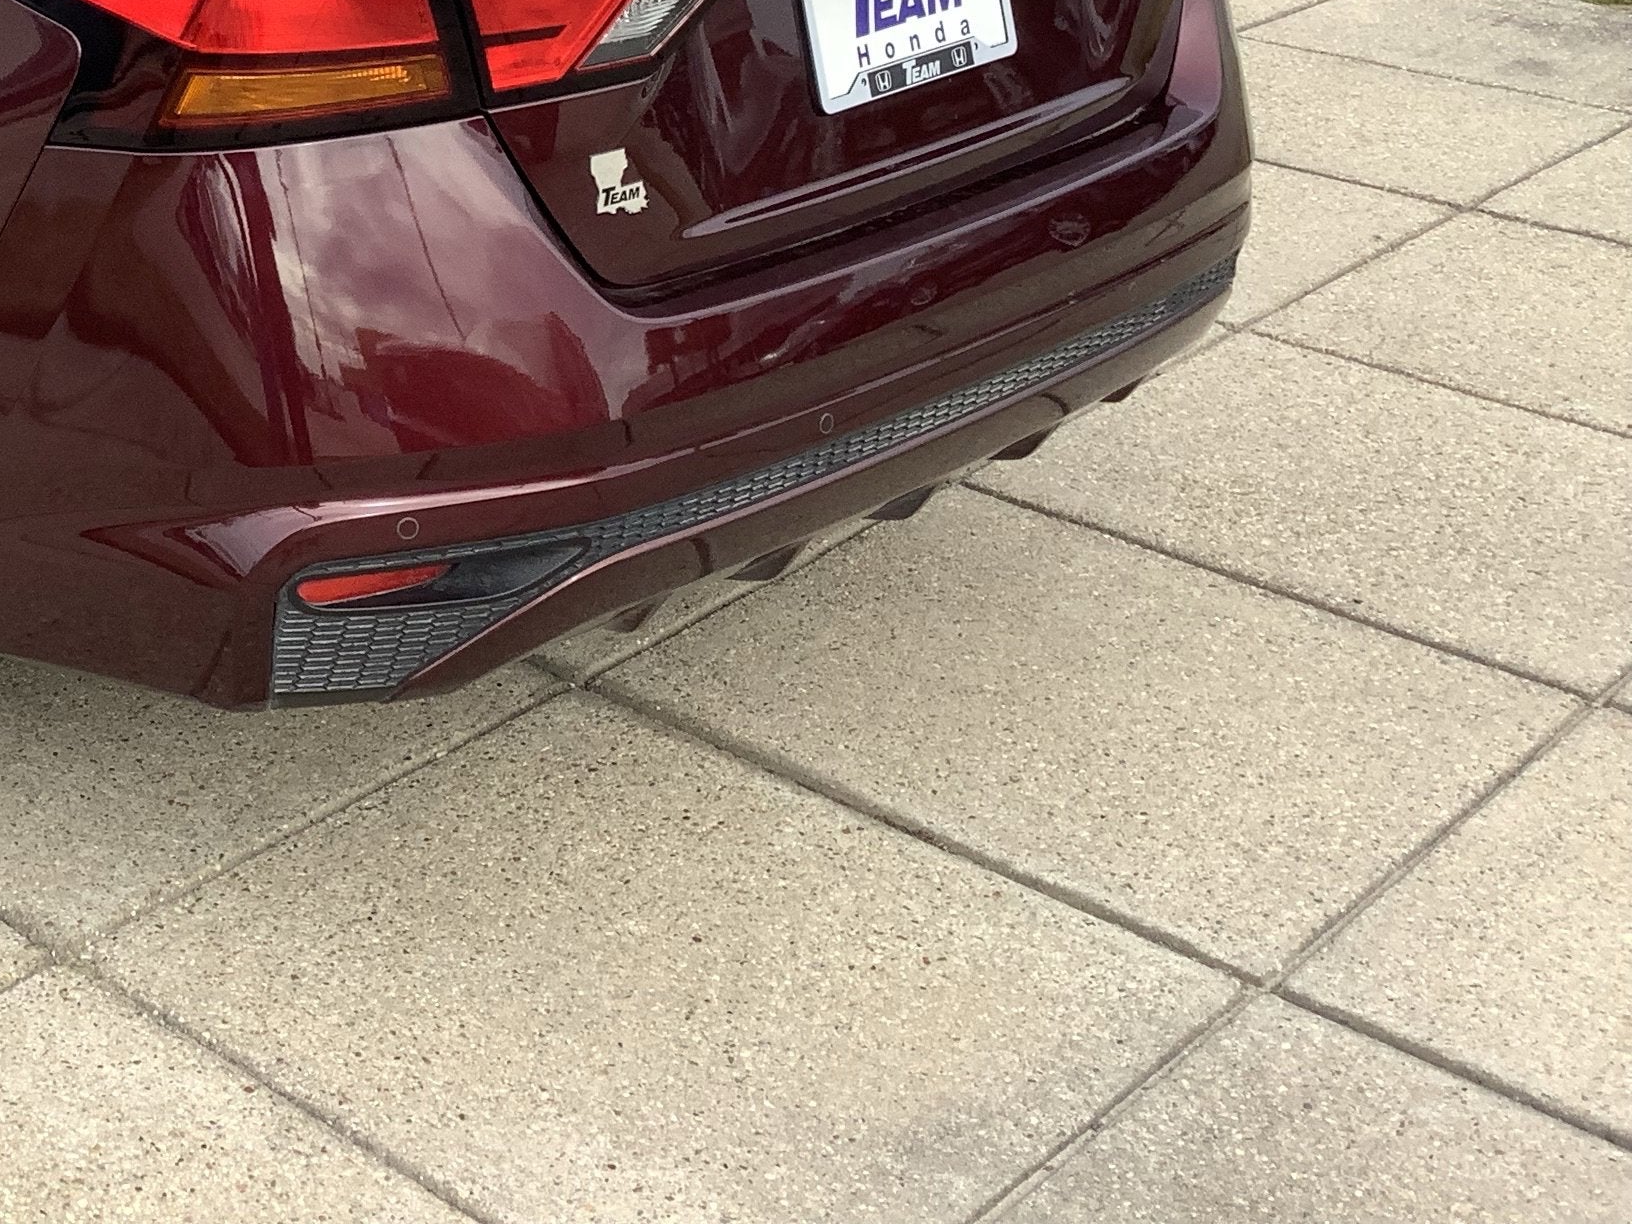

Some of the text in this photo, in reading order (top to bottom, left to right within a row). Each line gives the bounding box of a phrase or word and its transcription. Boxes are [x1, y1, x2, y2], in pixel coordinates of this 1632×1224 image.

[856, 18, 971, 69] Honda
[902, 58, 941, 87] TEAM
[601, 185, 641, 208] TEAM
